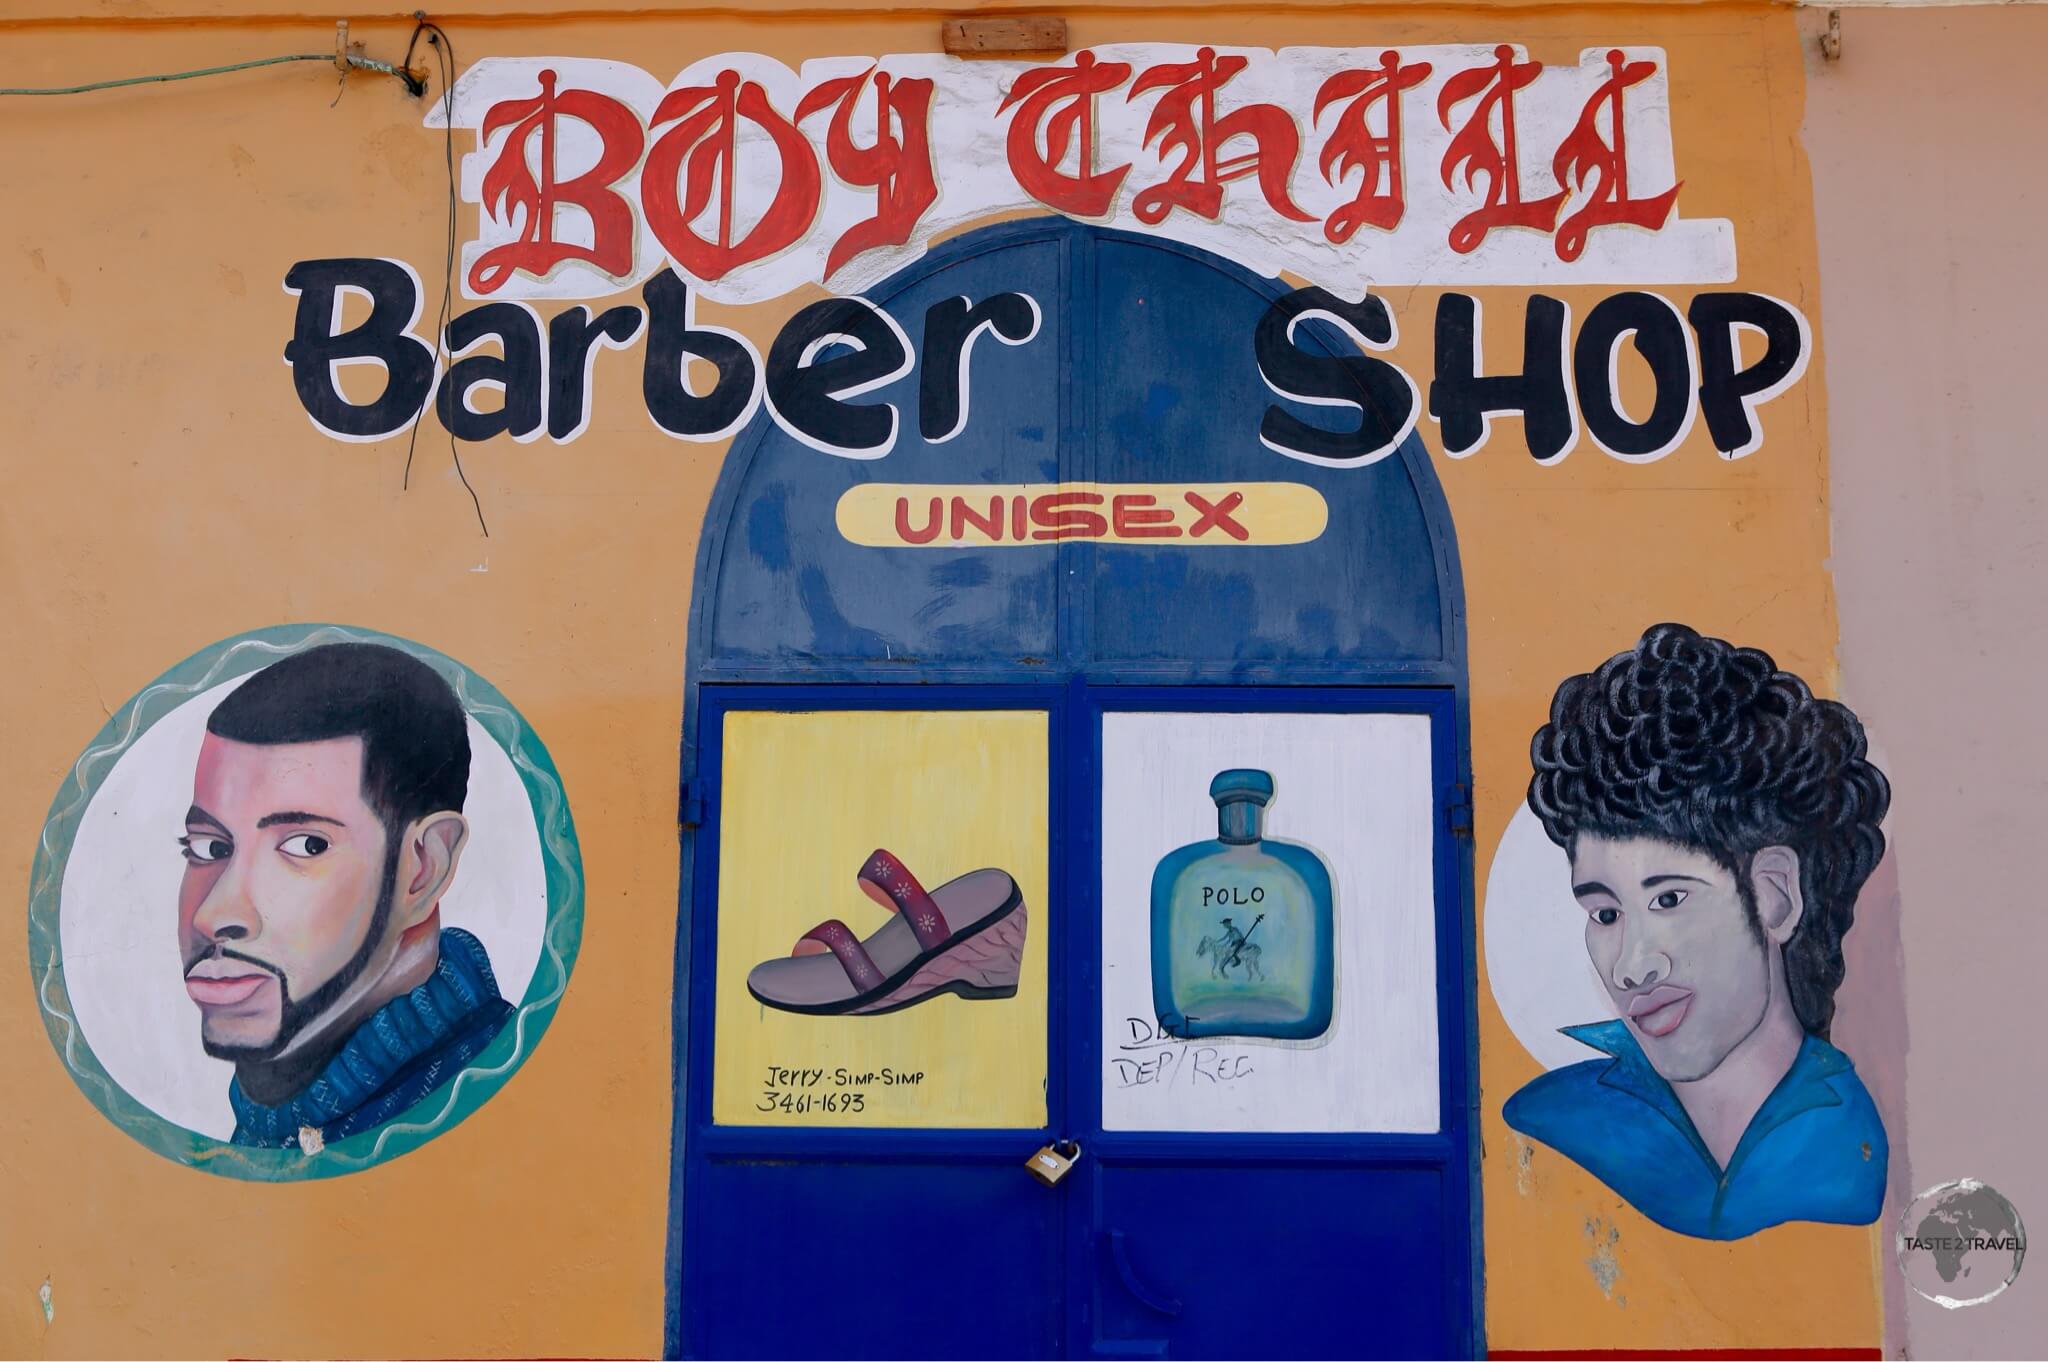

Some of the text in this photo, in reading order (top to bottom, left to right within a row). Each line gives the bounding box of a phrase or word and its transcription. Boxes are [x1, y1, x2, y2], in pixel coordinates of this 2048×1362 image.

[468, 64, 940, 295] BOY
[283, 256, 1813, 468] Barber SHOP
[895, 490, 1250, 545] UNISEX
[1201, 886, 1266, 907] POLO
[756, 1092, 865, 1113] 3461-1693
